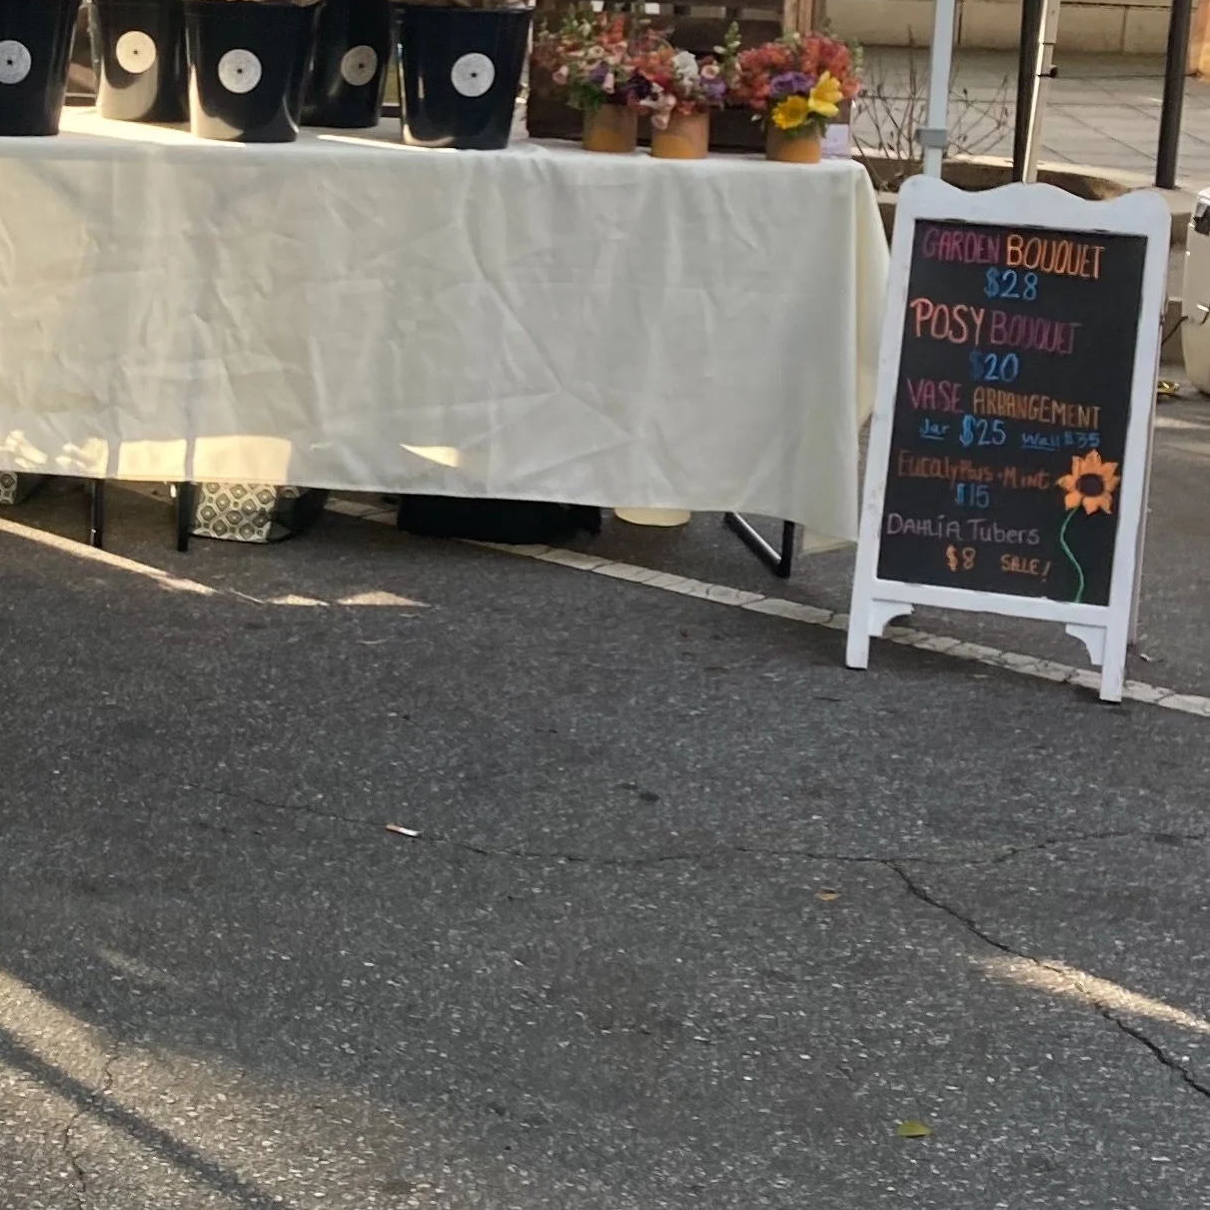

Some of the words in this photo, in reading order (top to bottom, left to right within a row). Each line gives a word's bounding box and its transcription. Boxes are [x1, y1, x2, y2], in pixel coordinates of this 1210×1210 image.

[922, 229, 1000, 264] GARDEN
[1006, 234, 1105, 279] BOUQUET
[984, 267, 1039, 301] $28
[909, 297, 985, 346] POSY
[990, 309, 1082, 355] BOUQUET
[969, 352, 1020, 381] $20
[906, 378, 965, 413] VASE
[973, 385, 1101, 431] ARRANGEMENT
[919, 417, 951, 435] Jar
[959, 414, 1007, 447] $25
[955, 483, 991, 508] $15
[968, 518, 1041, 546] Tubers
[945, 544, 977, 573] $8
